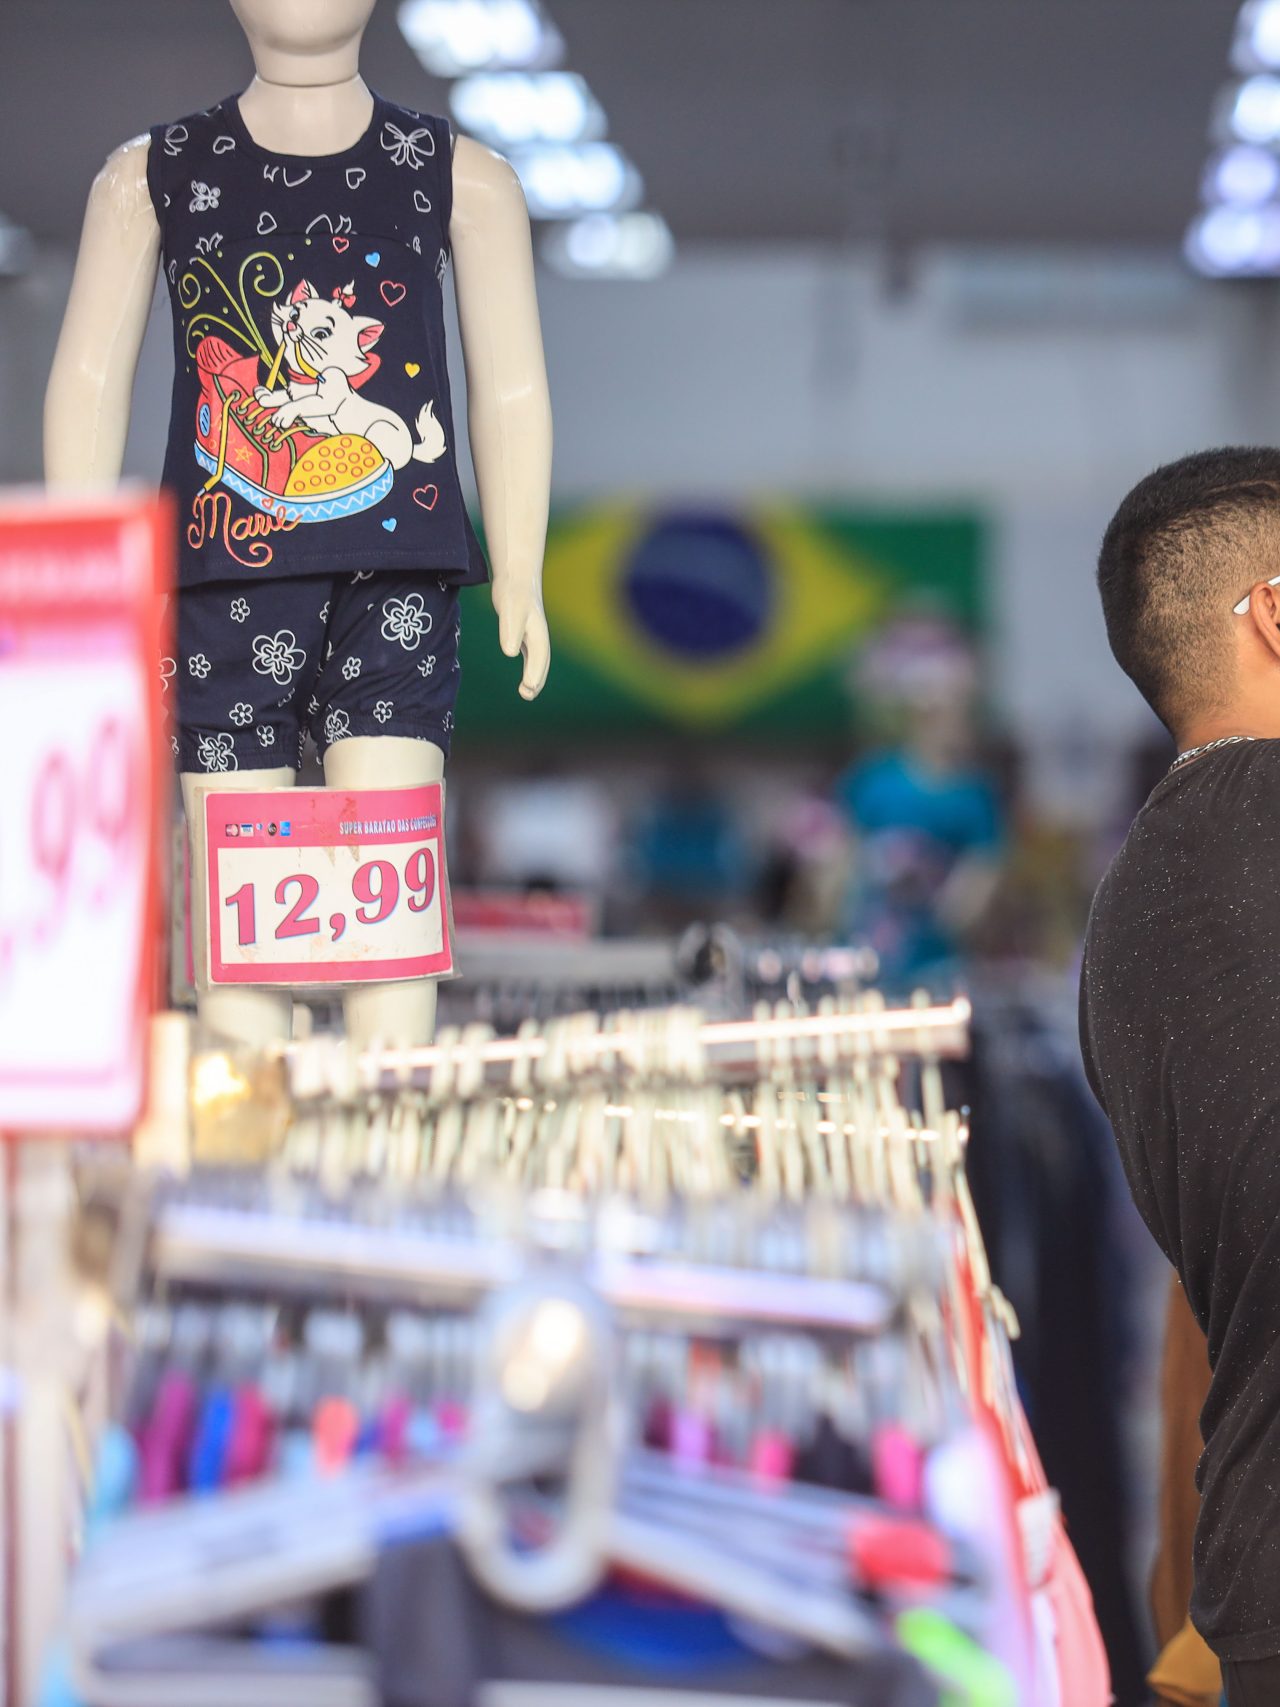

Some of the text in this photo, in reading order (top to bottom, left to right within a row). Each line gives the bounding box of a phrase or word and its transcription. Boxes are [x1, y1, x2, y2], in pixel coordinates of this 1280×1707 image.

[187, 491, 303, 567] Marie
[339, 820, 363, 835] SUPER
[397, 818, 409, 833] DAS
[225, 847, 435, 945] 12,99
